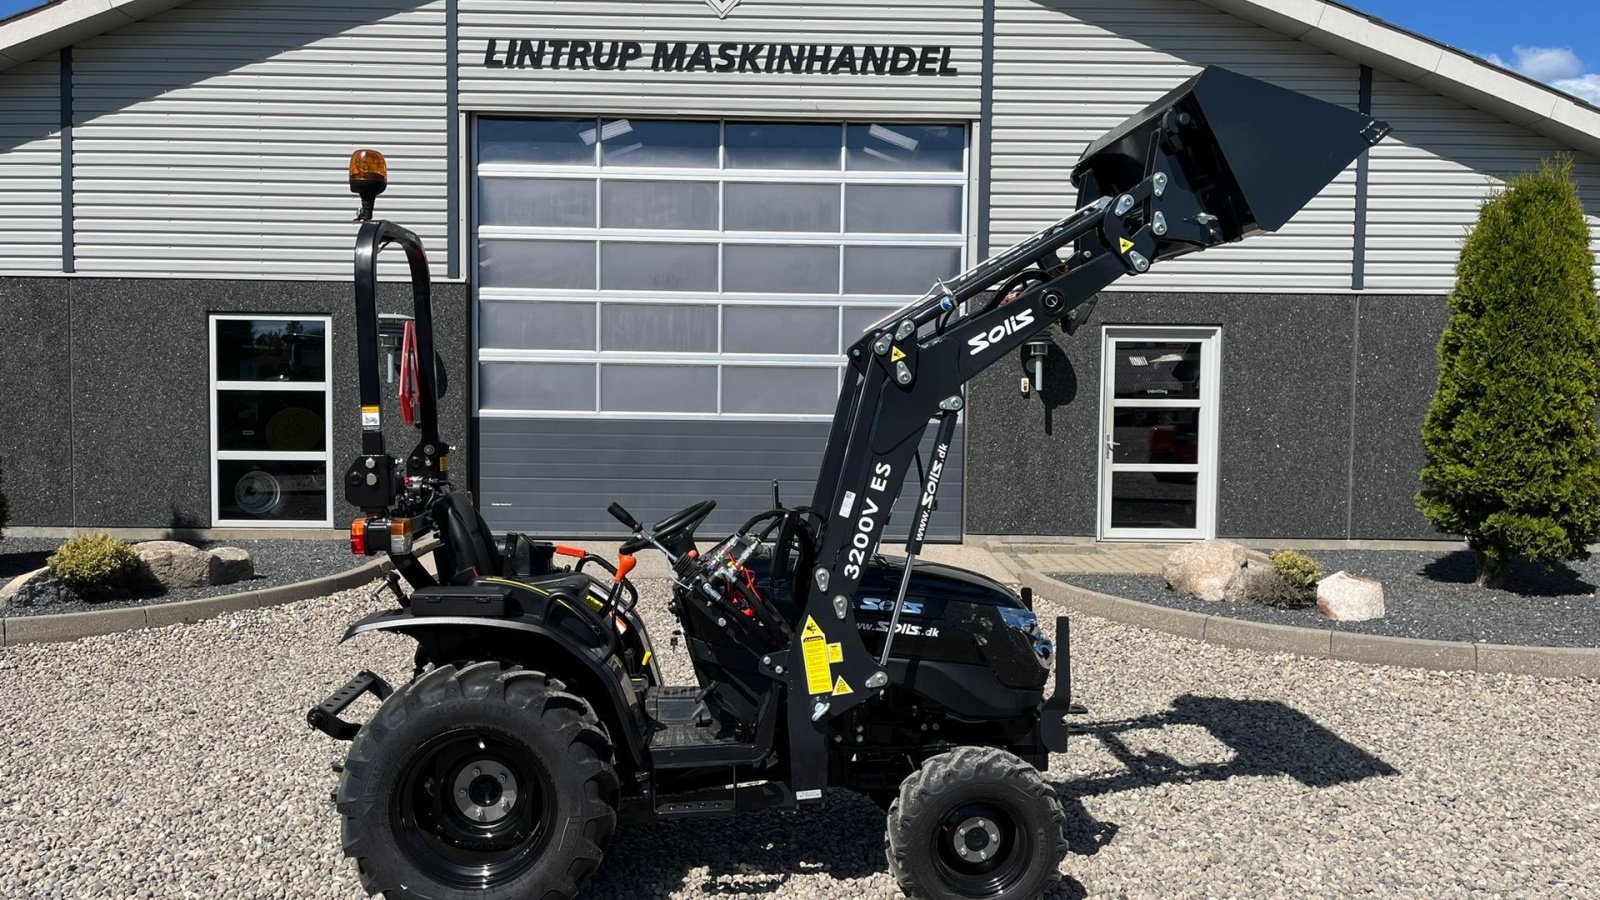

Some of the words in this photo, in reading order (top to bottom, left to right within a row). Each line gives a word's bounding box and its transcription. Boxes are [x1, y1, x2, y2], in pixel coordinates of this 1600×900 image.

[484, 39, 642, 71] LINTRUP
[651, 41, 958, 76] MASKINHANDEL
[844, 497, 879, 580] 3200V
[870, 462, 892, 492] ES
